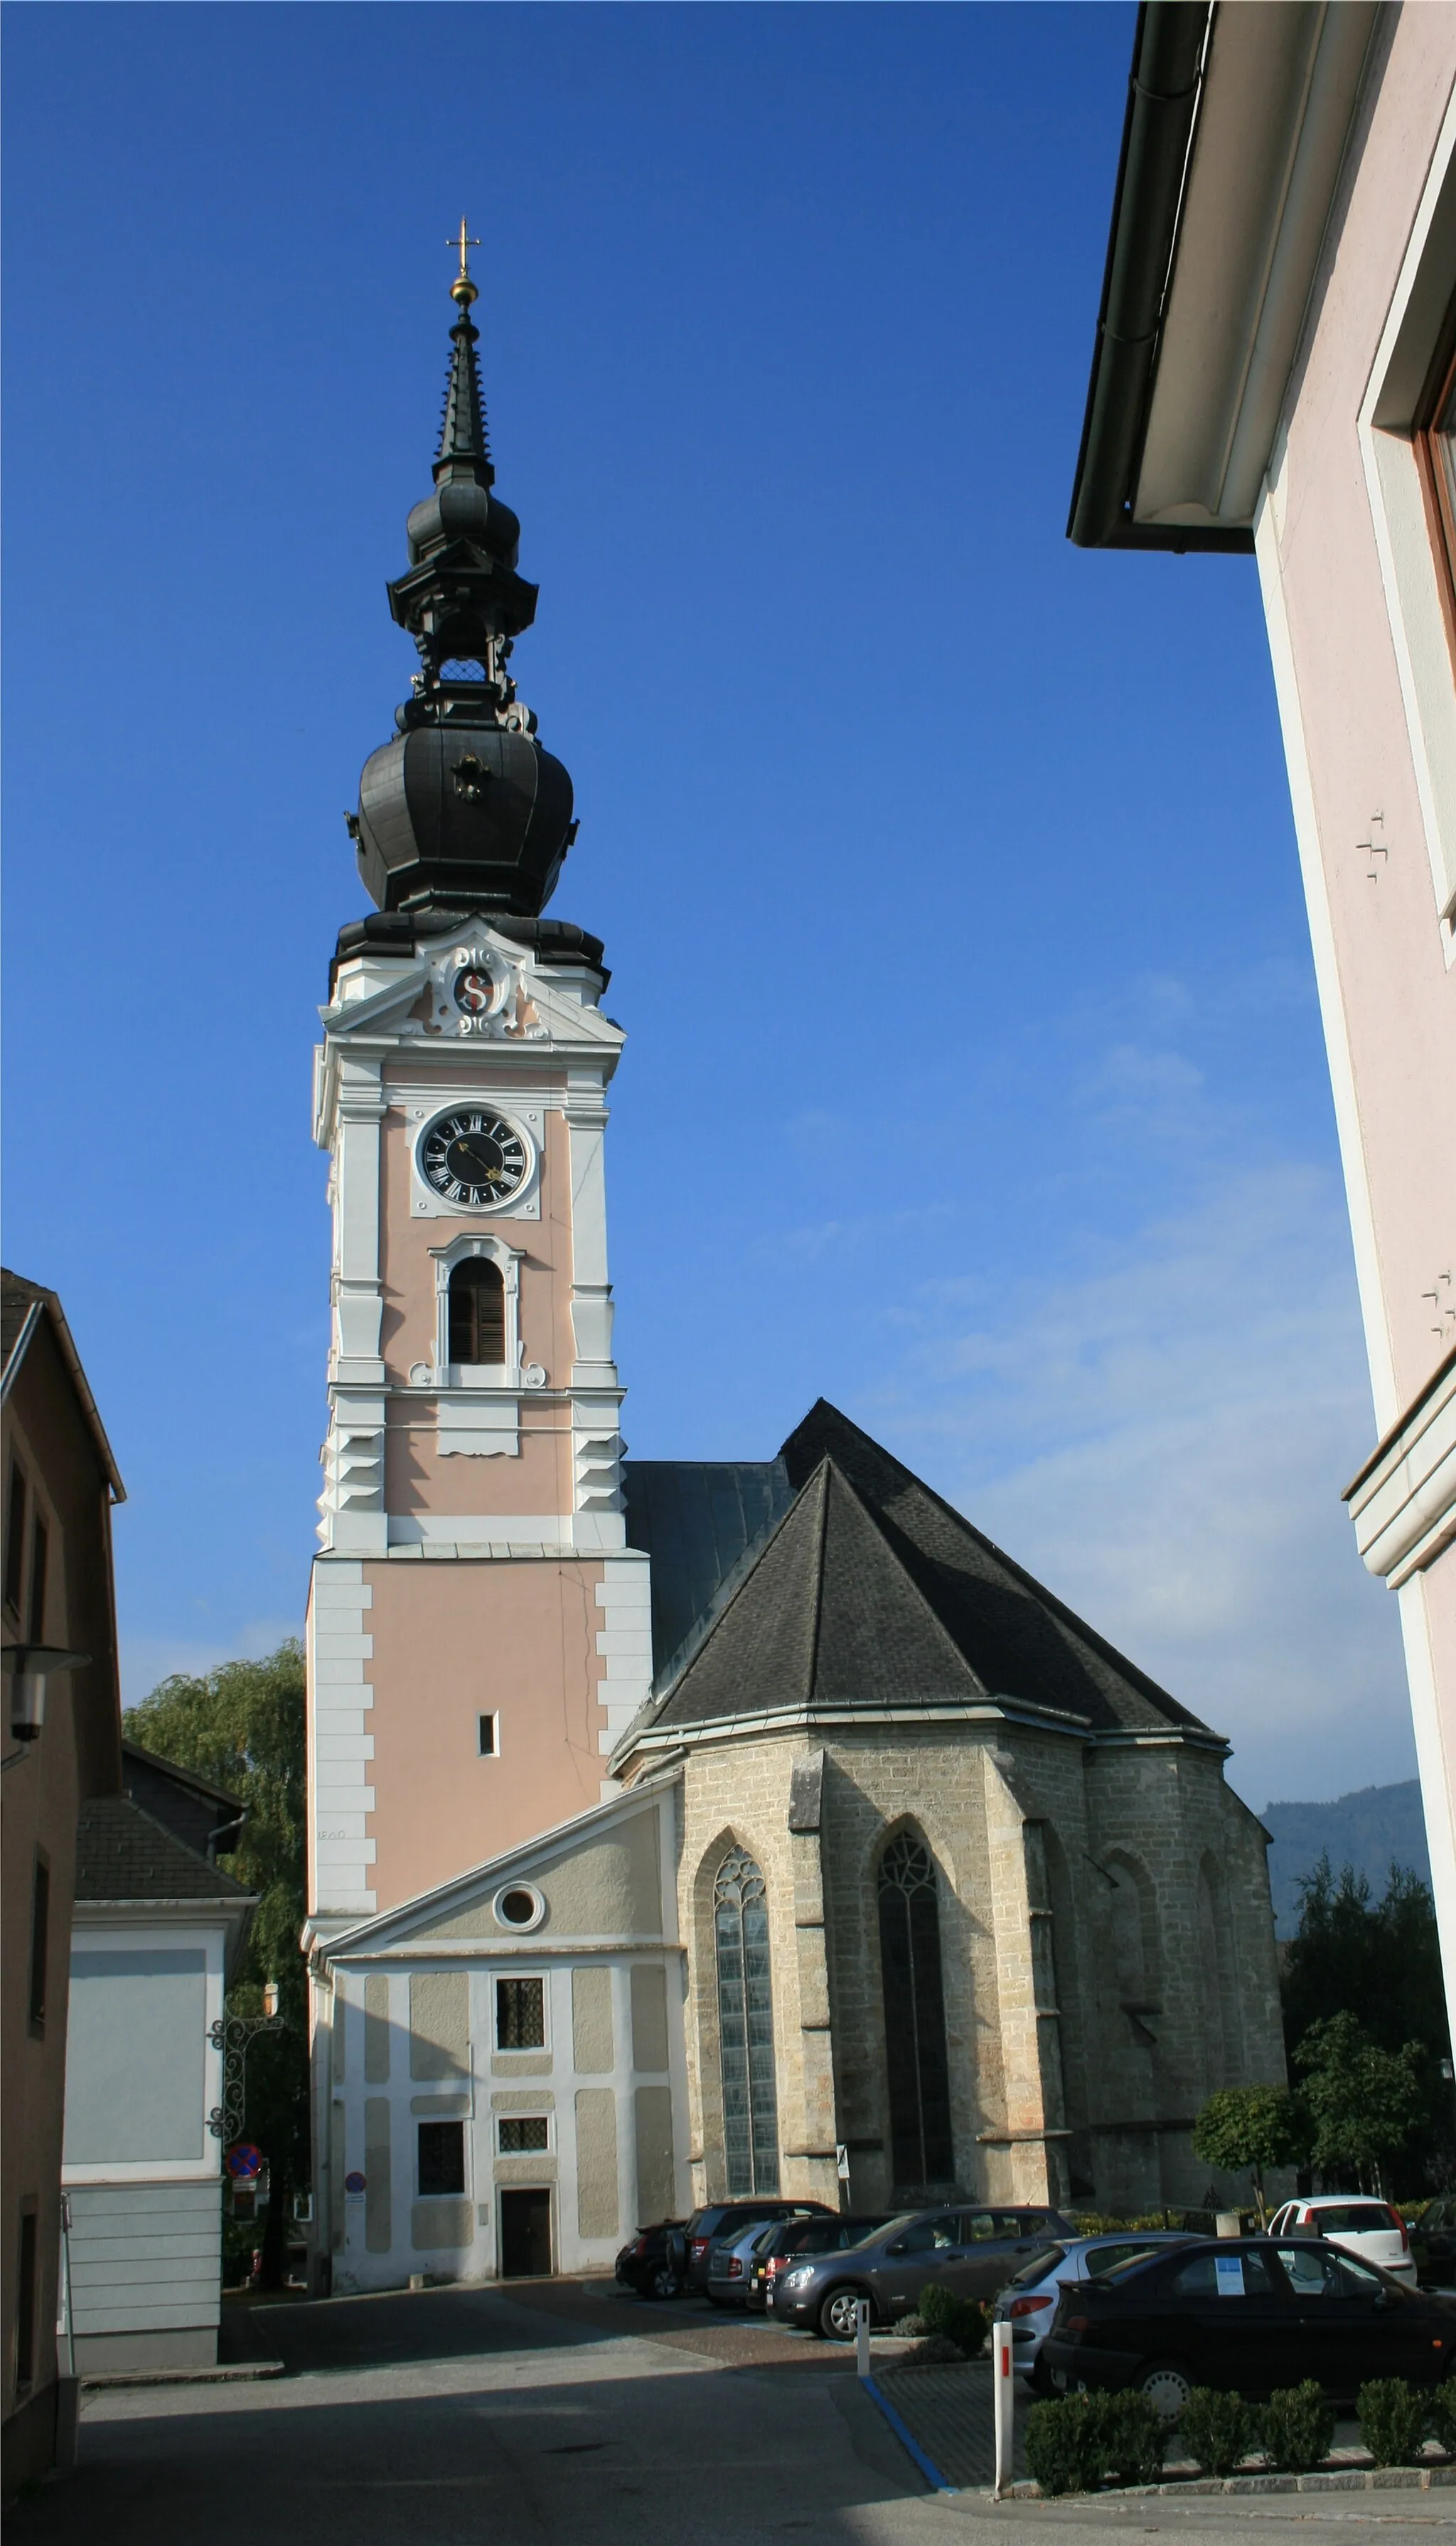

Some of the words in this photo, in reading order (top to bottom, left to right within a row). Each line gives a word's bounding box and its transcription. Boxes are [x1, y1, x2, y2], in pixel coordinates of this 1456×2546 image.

[459, 975, 486, 1010] S
[469, 1115, 482, 1131] XII
[490, 1122, 501, 1136] I
[500, 1136, 518, 1149] II
[505, 1155, 523, 1166] III
